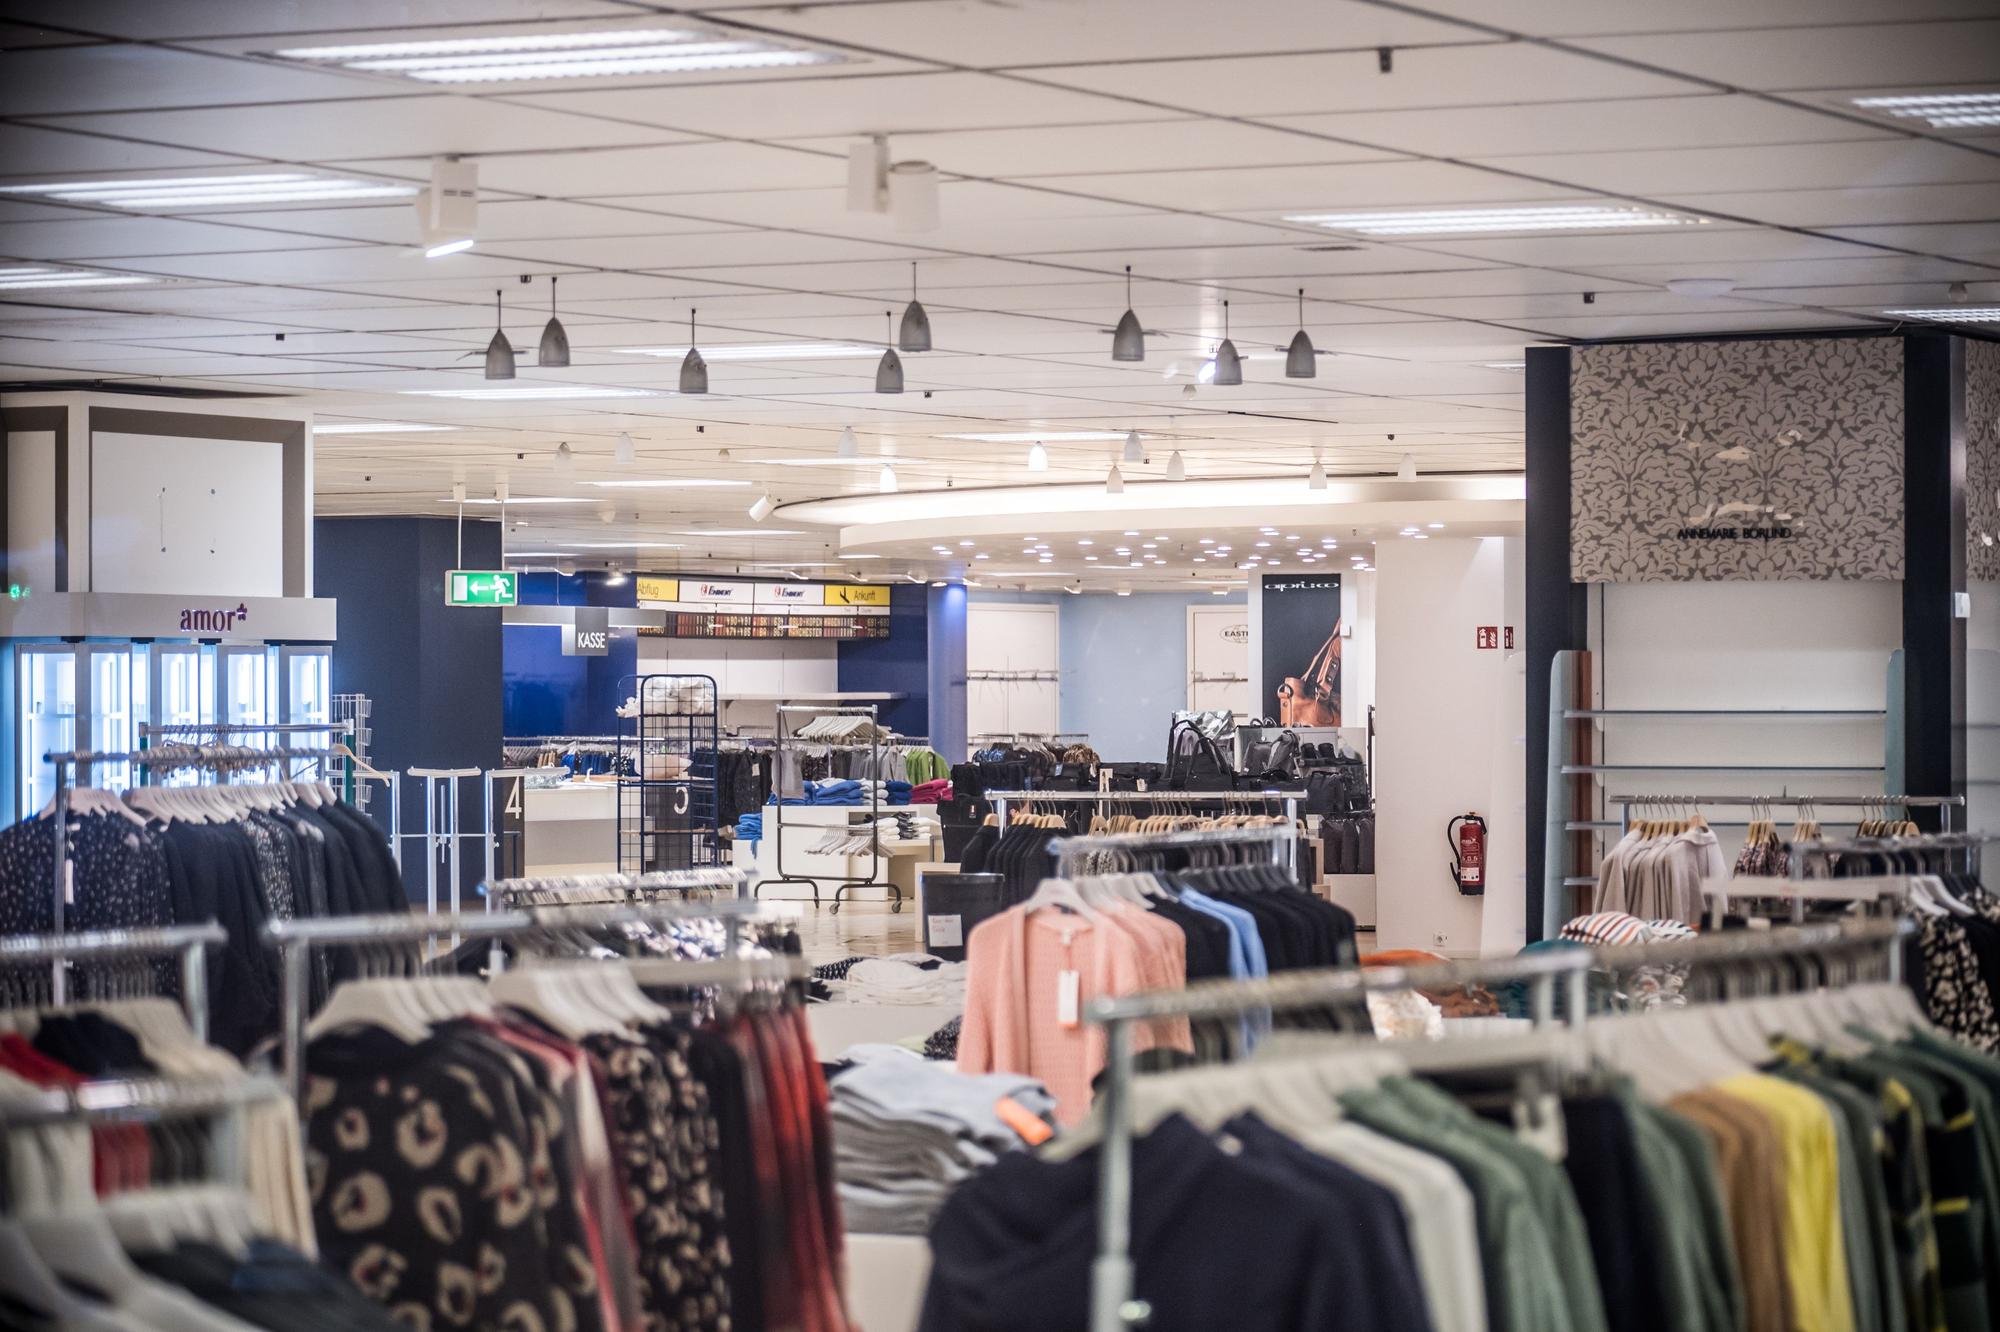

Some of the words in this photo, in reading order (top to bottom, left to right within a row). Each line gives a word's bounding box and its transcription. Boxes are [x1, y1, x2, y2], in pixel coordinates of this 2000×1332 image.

[1677, 527, 1738, 540] ANNEMARIE
[637, 582, 660, 598] Abflug
[854, 590, 876, 601] Ankunft
[180, 608, 236, 632] amor
[577, 632, 606, 649] KASSE
[504, 775, 522, 820] 4
